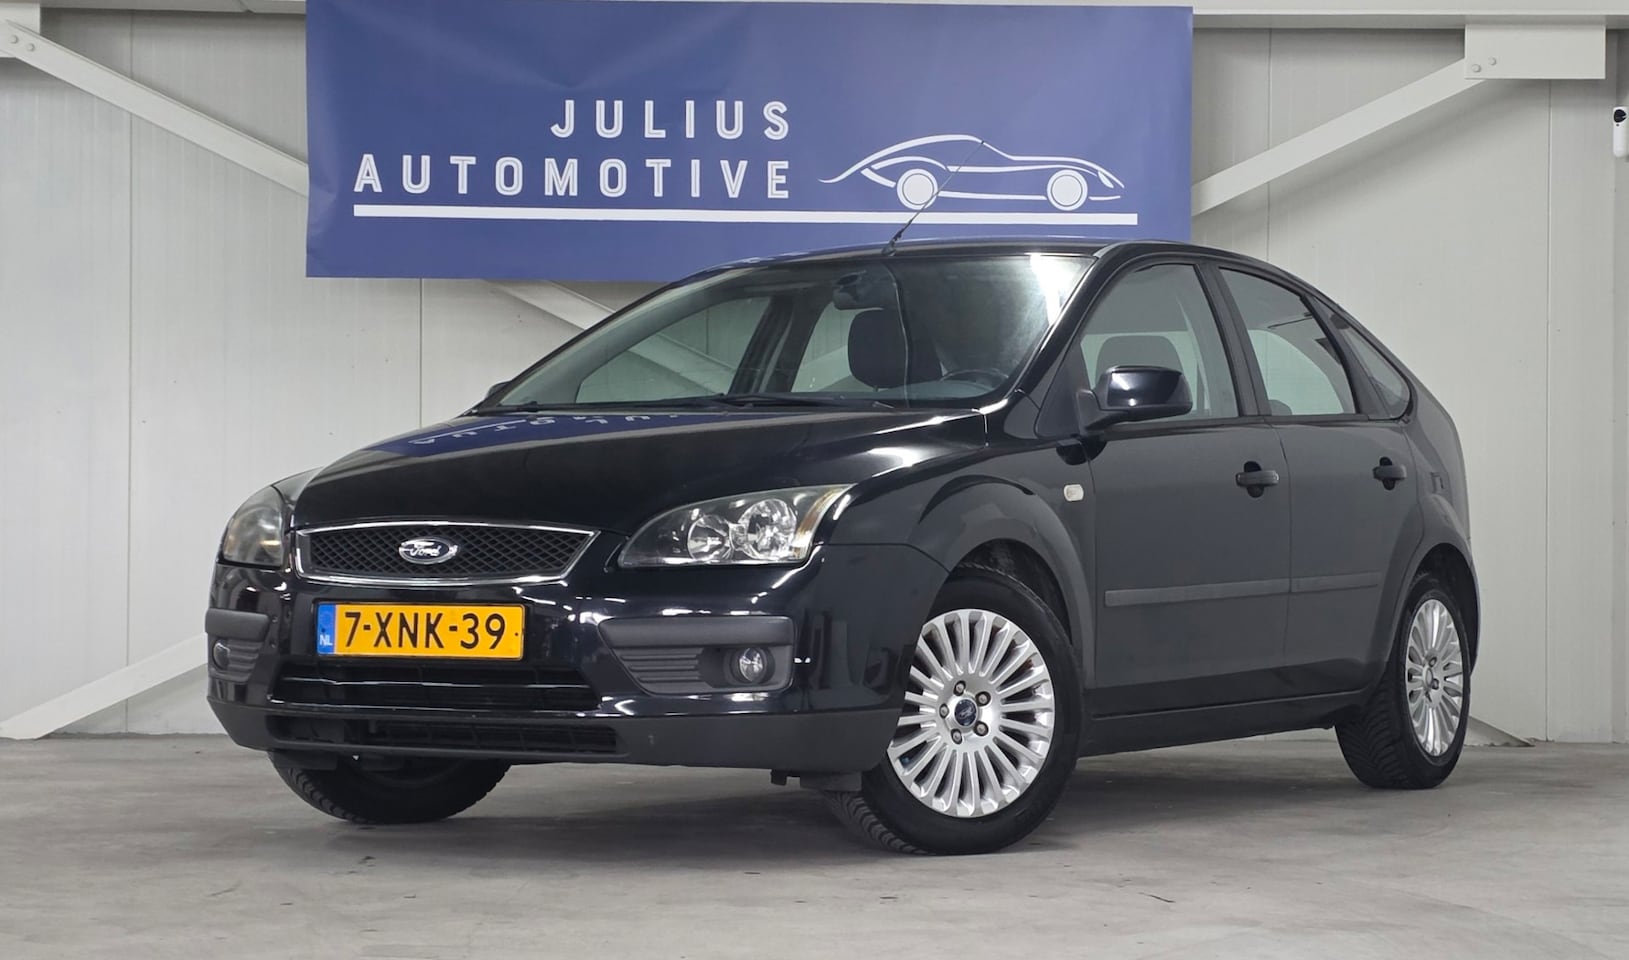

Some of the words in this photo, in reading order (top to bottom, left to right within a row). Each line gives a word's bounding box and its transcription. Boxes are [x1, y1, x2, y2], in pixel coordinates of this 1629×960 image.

[550, 99, 790, 141] JULIUS
[353, 153, 790, 199] AUTOMOTIVE
[319, 634, 334, 647] NL
[344, 611, 507, 650] 7-XNK-39
